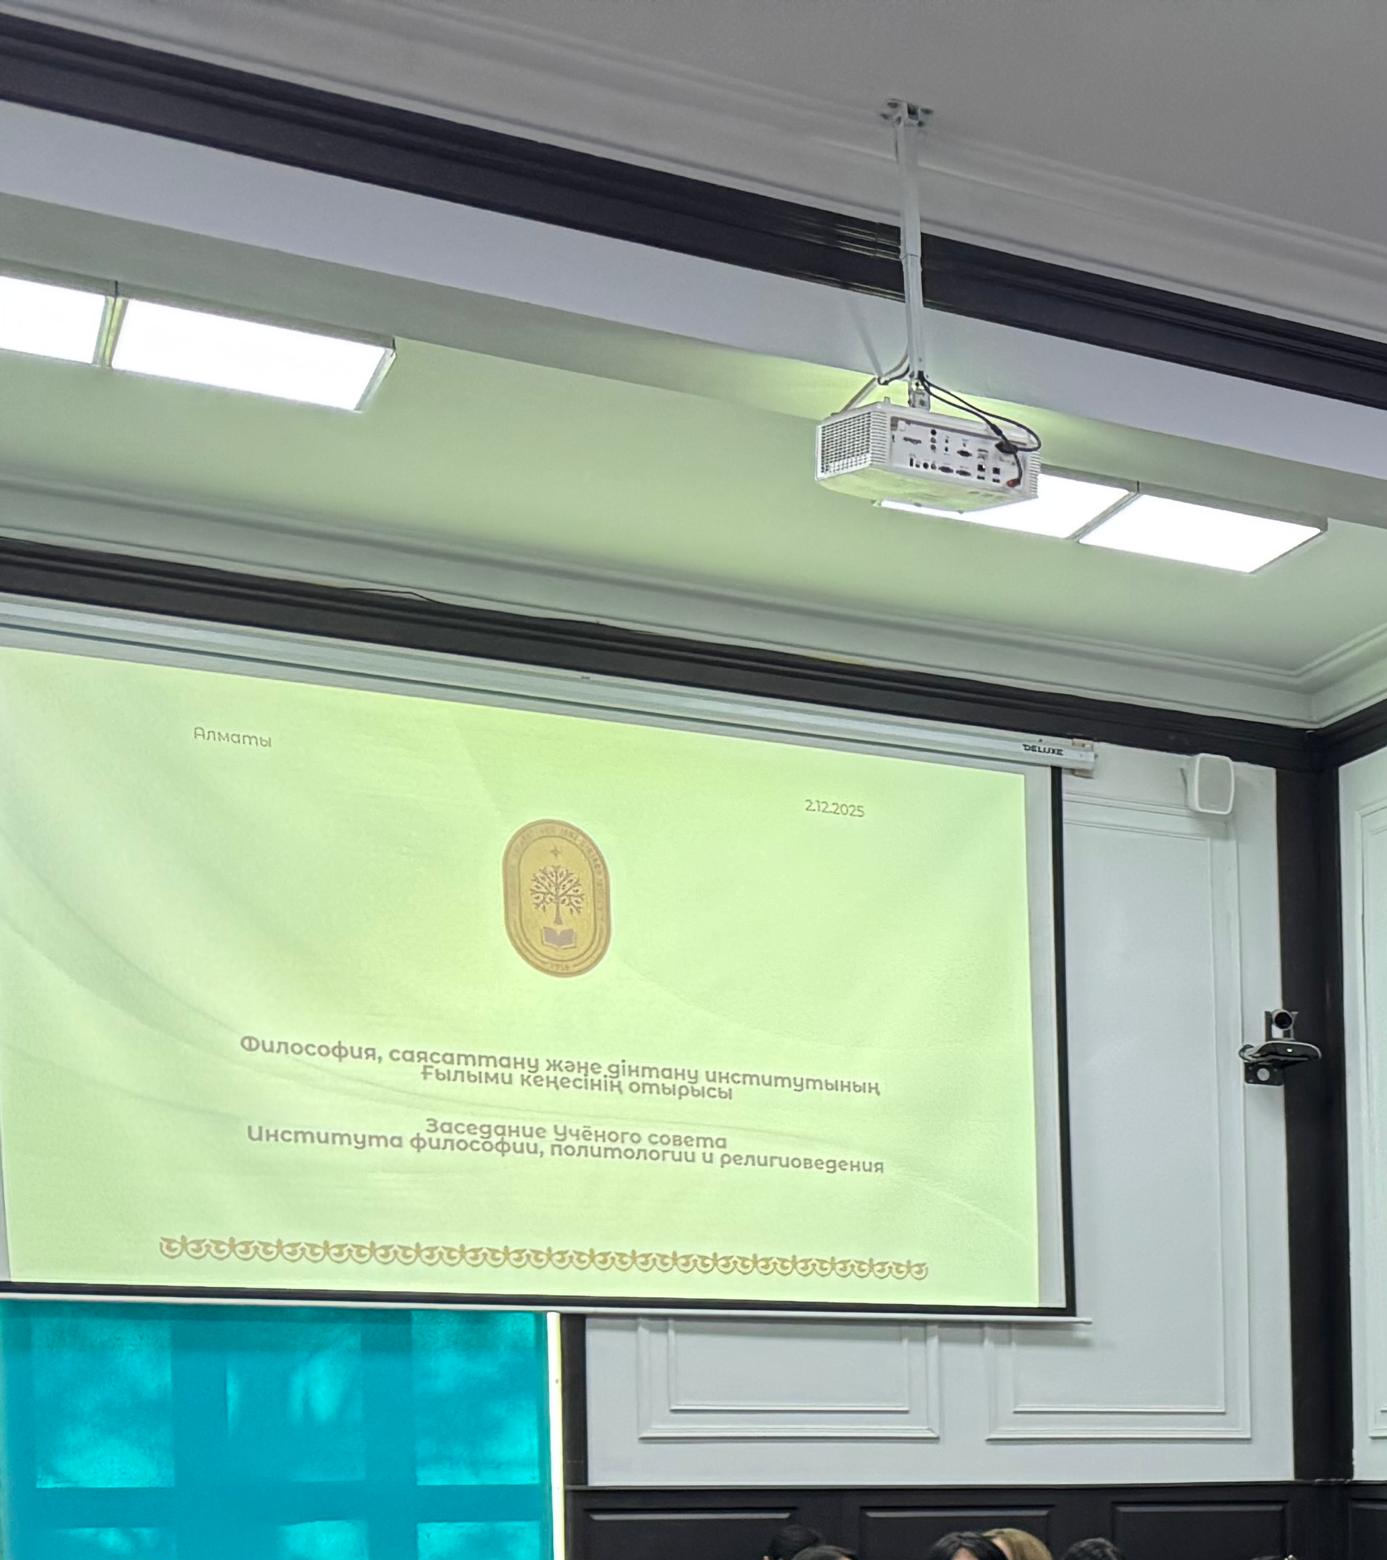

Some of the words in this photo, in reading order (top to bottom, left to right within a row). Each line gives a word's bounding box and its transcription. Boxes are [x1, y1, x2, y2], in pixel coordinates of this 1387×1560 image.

[194, 726, 272, 748] Алматы
[805, 799, 865, 818] 2.12.2025
[240, 1036, 383, 1063] Философия,
[388, 1048, 539, 1074] саясаттану
[607, 1059, 699, 1084] дінтану
[705, 1070, 881, 1096] институтының
[421, 1065, 513, 1086] Ғылыми
[520, 1073, 623, 1095] кеңесінің
[629, 1080, 733, 1100] отырысы
[247, 1126, 403, 1150] Института
[410, 1133, 544, 1158] философии,
[550, 1143, 696, 1164] политологии
[702, 1151, 714, 1164] и
[720, 1153, 884, 1174] религиоведения
[425, 1118, 547, 1140] Заседание
[553, 1124, 642, 1145] Учёного
[648, 1133, 728, 1150] совета
